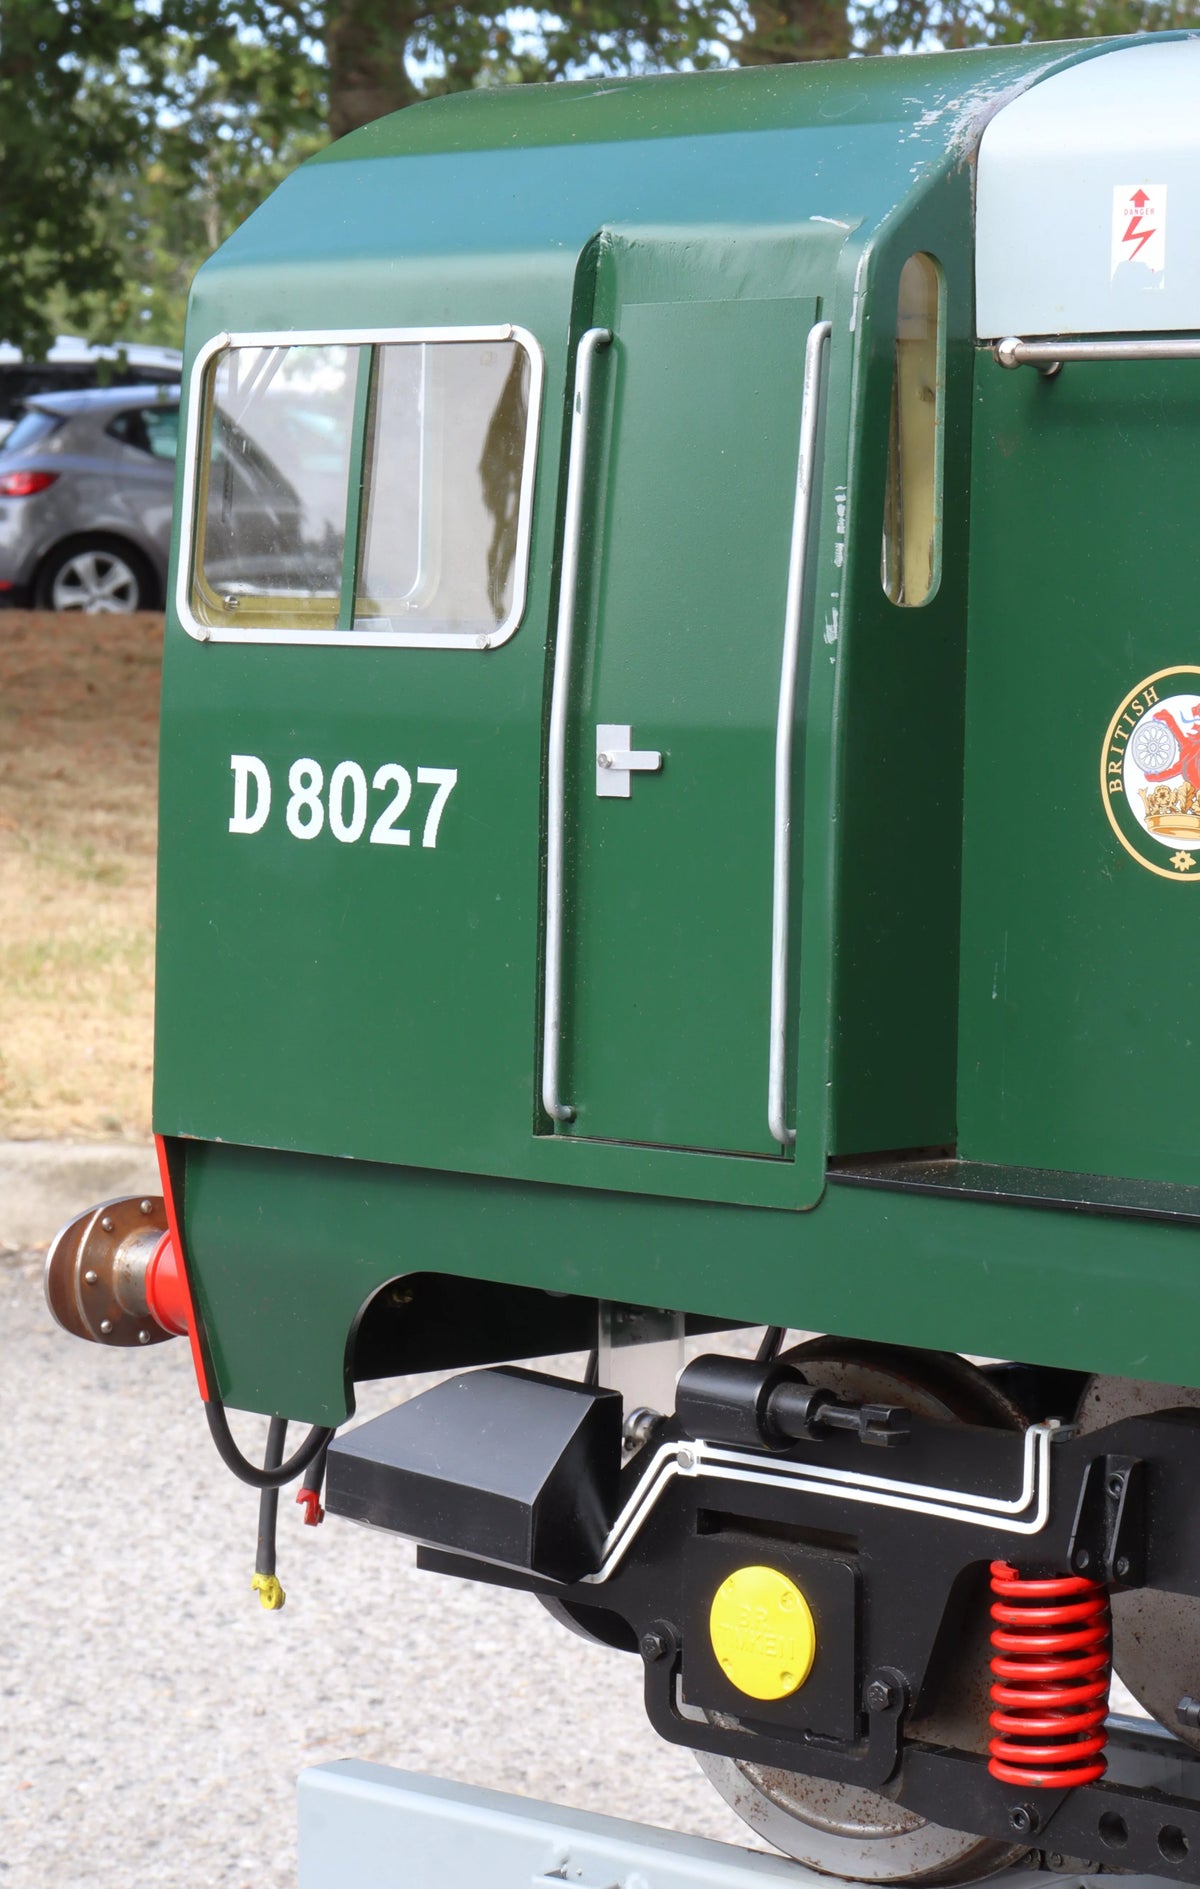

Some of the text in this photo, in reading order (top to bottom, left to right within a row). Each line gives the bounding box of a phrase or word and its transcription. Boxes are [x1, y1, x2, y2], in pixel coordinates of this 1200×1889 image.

[1124, 208, 1155, 216] DANGER
[1108, 686, 1160, 794] BRITISH
[228, 754, 458, 849] D 8027
